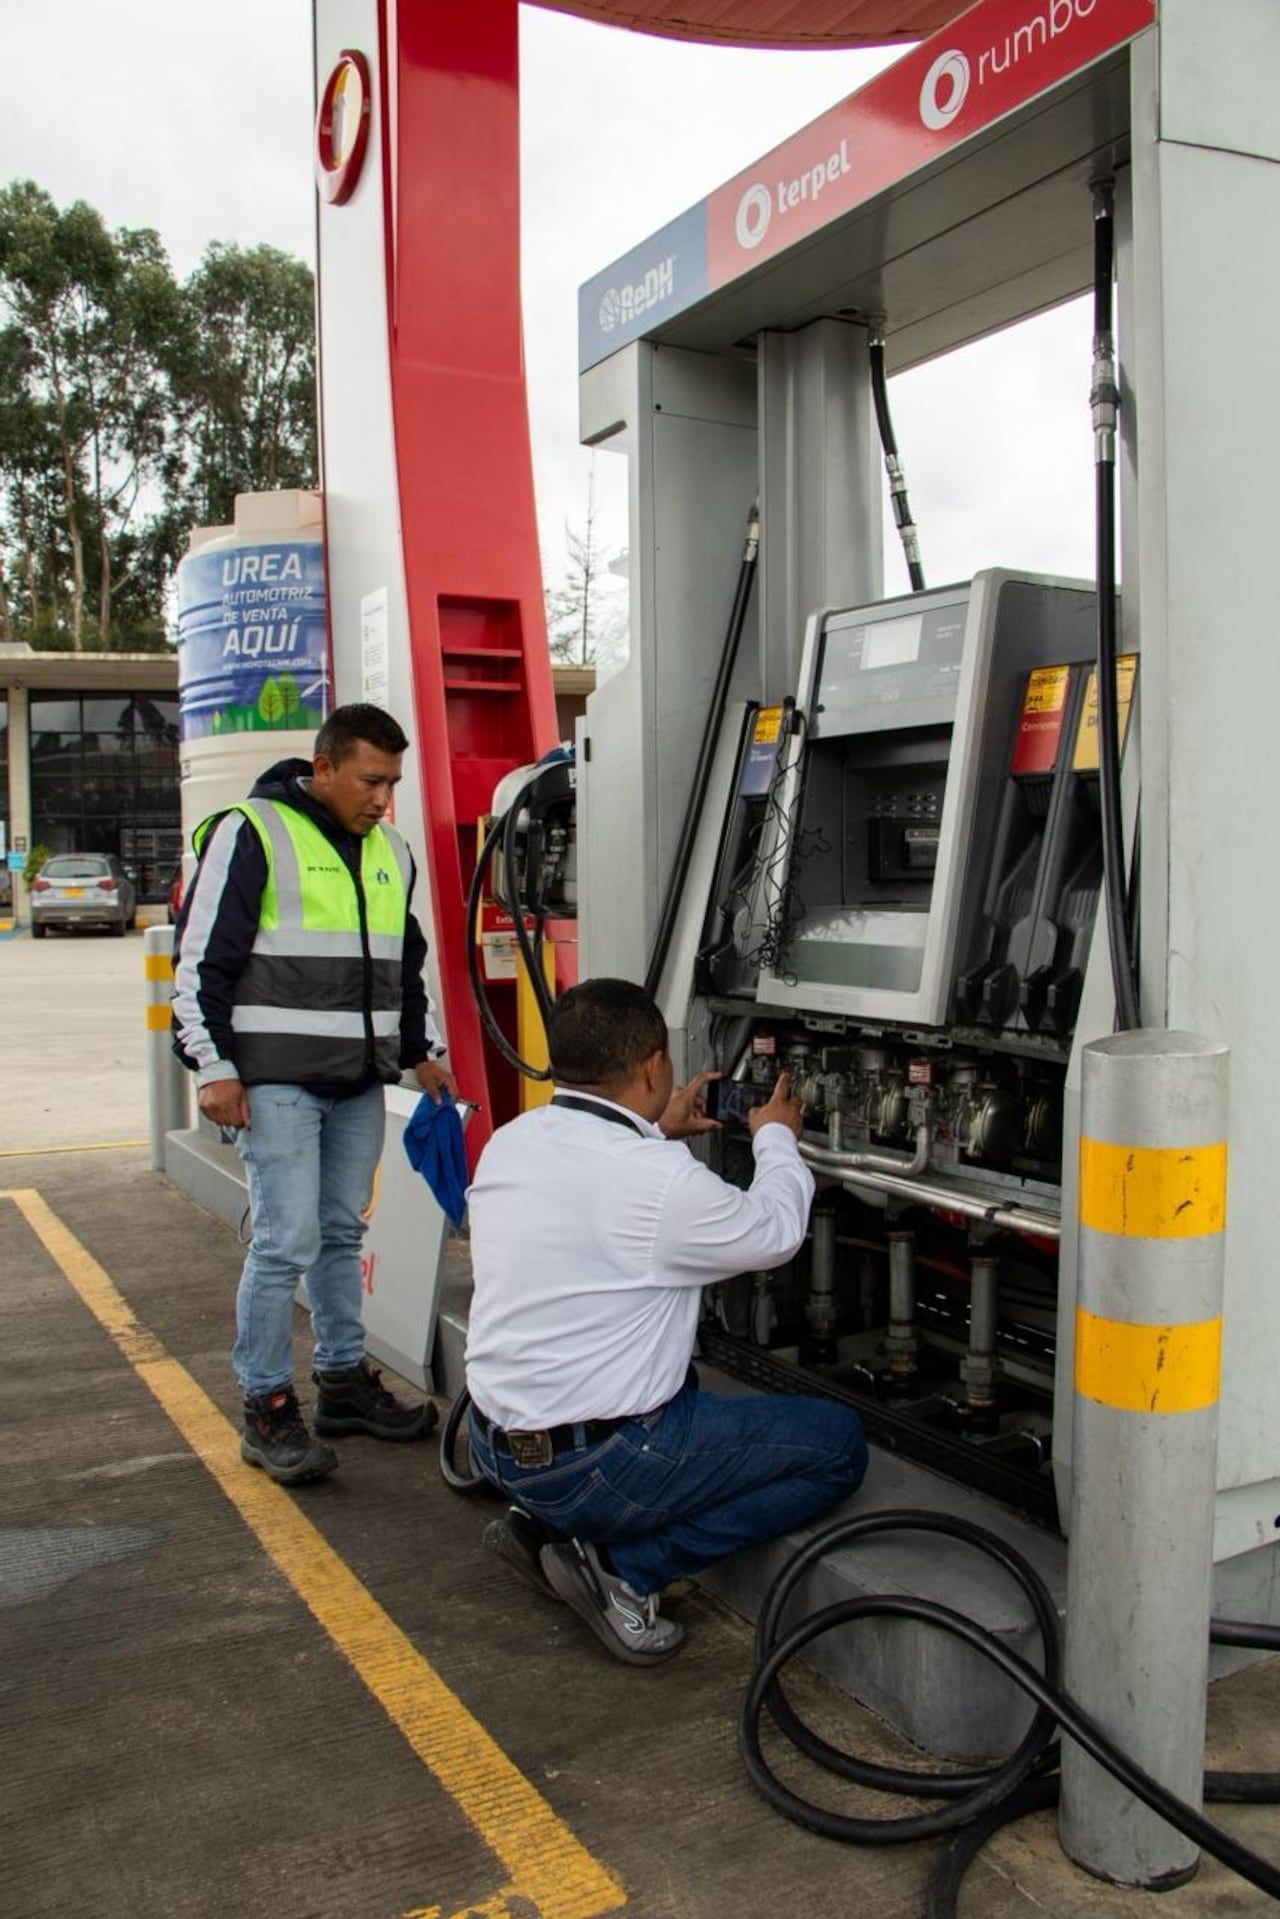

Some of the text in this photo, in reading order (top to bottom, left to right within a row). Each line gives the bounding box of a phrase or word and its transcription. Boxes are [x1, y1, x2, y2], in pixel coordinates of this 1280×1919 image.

[777, 138, 851, 214] terpel
[222, 552, 302, 587] UREA
[222, 587, 314, 608] AUTOMOTRIZ
[222, 607, 288, 625] DE VENTA
[222, 614, 303, 659] AQUÍ
